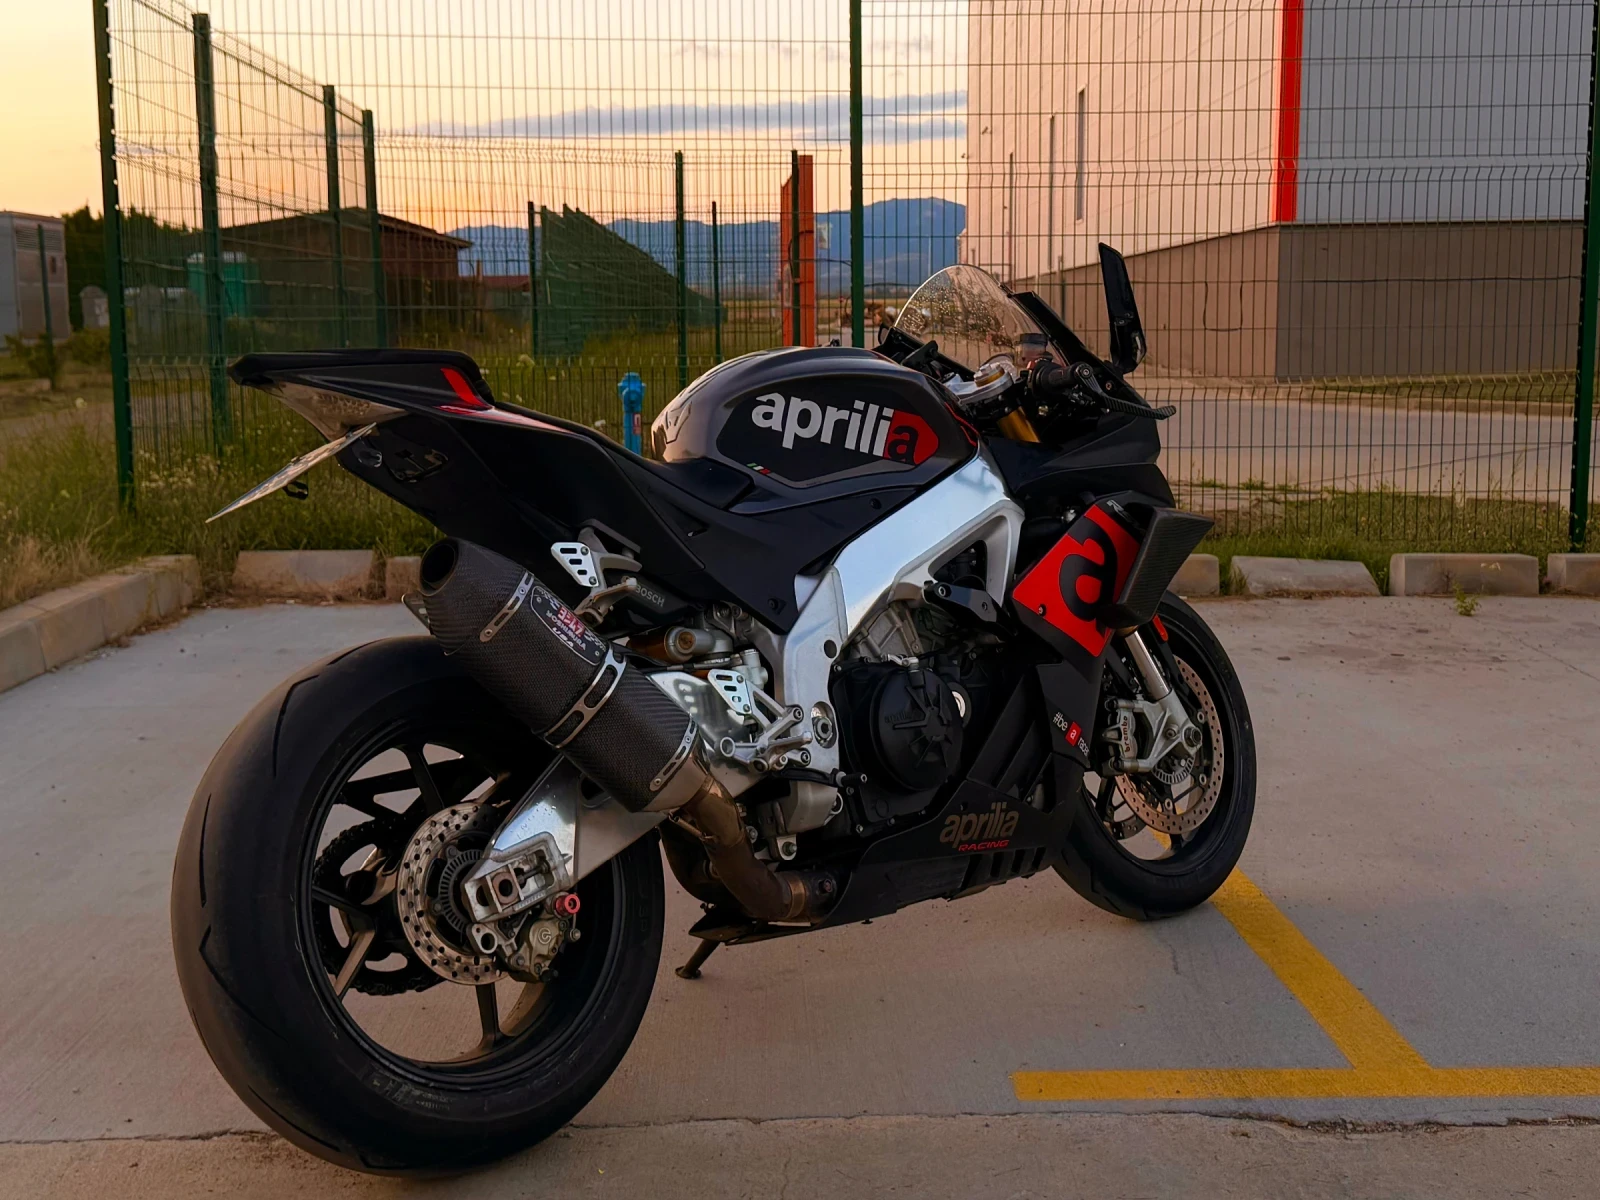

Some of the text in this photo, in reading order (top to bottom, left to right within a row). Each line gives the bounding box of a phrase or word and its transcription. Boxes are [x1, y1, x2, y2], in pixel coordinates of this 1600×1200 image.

[751, 392, 919, 465] aprilia
[636, 584, 664, 607] BOSCH
[546, 610, 586, 651] YOSHIMURA
[1122, 715, 1131, 753] brembo
[940, 802, 1019, 848] aprilia
[958, 839, 1010, 852] RACING
